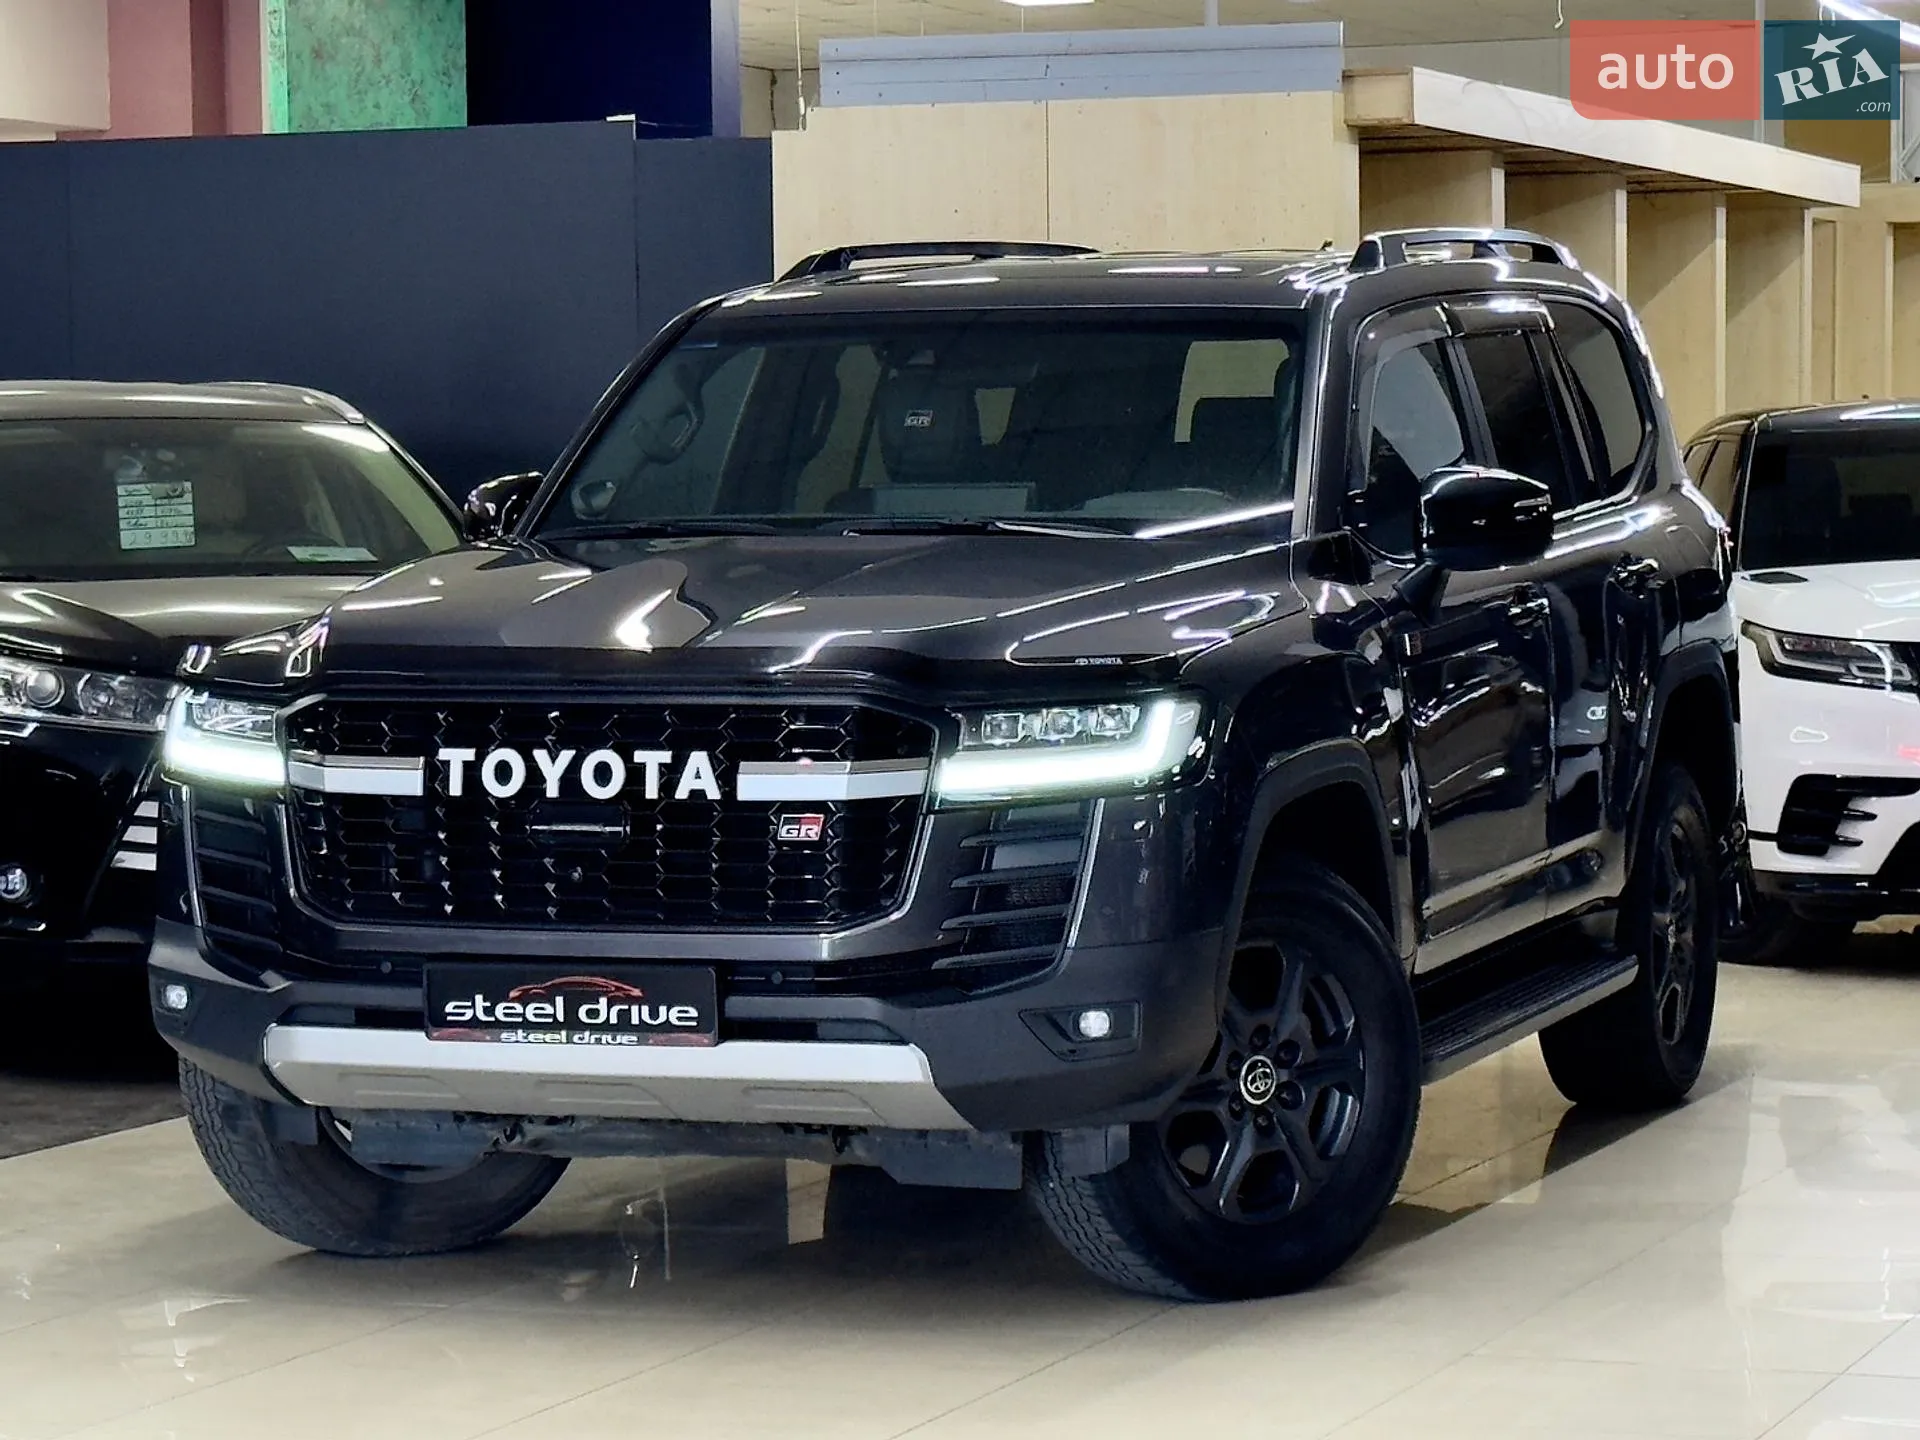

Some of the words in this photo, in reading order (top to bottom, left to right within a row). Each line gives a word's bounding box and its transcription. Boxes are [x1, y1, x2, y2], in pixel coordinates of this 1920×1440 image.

[438, 748, 722, 800] TOYOTA
[780, 824, 819, 838] GR
[444, 993, 564, 1022] steel
[578, 996, 699, 1026] drive
[500, 1029, 567, 1044] steel
[572, 1031, 639, 1045] drive
